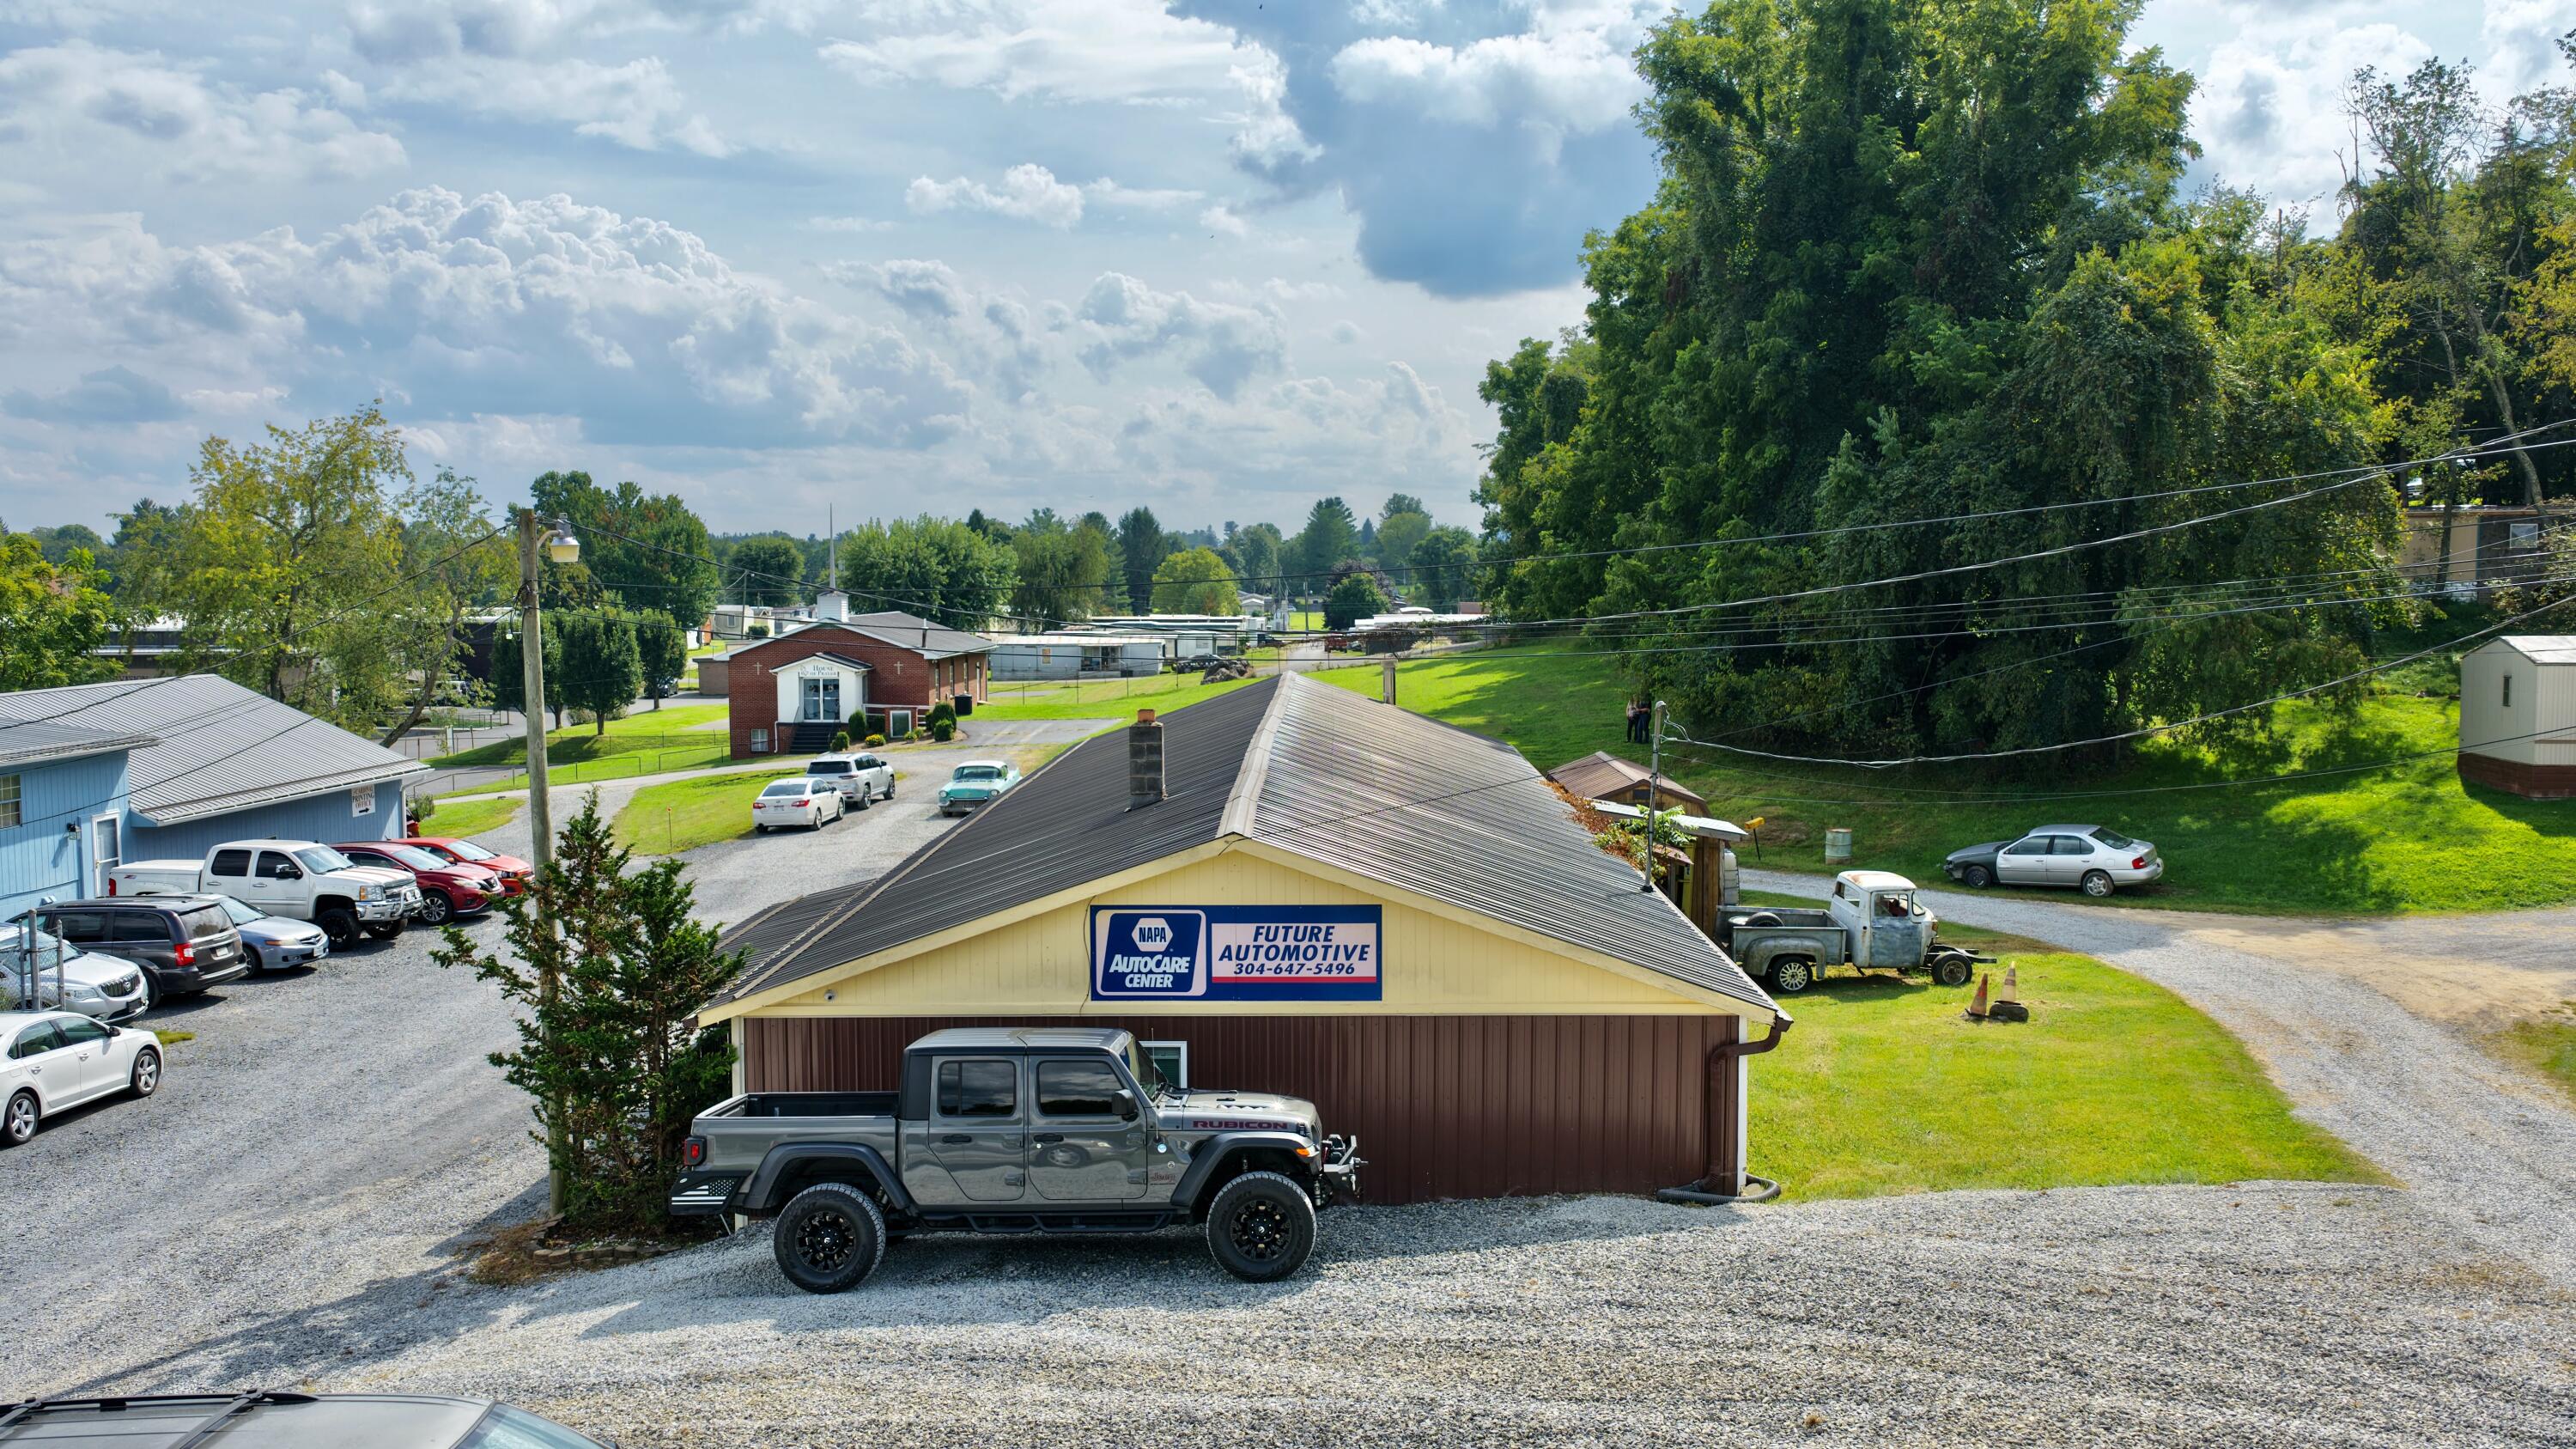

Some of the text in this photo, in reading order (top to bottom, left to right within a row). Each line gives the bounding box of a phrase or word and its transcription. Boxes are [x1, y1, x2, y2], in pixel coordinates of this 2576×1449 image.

[352, 793, 375, 802] PRINTING
[355, 799, 371, 808] OFFICE
[1138, 927, 1167, 942] NAPA
[1253, 925, 1335, 943] FUTURE
[1218, 944, 1370, 962] AUTOMOTIVE
[1233, 963, 1355, 975] 304-647-5496
[1125, 973, 1173, 988] CENTER
[1193, 1120, 1288, 1129] RUBICON
